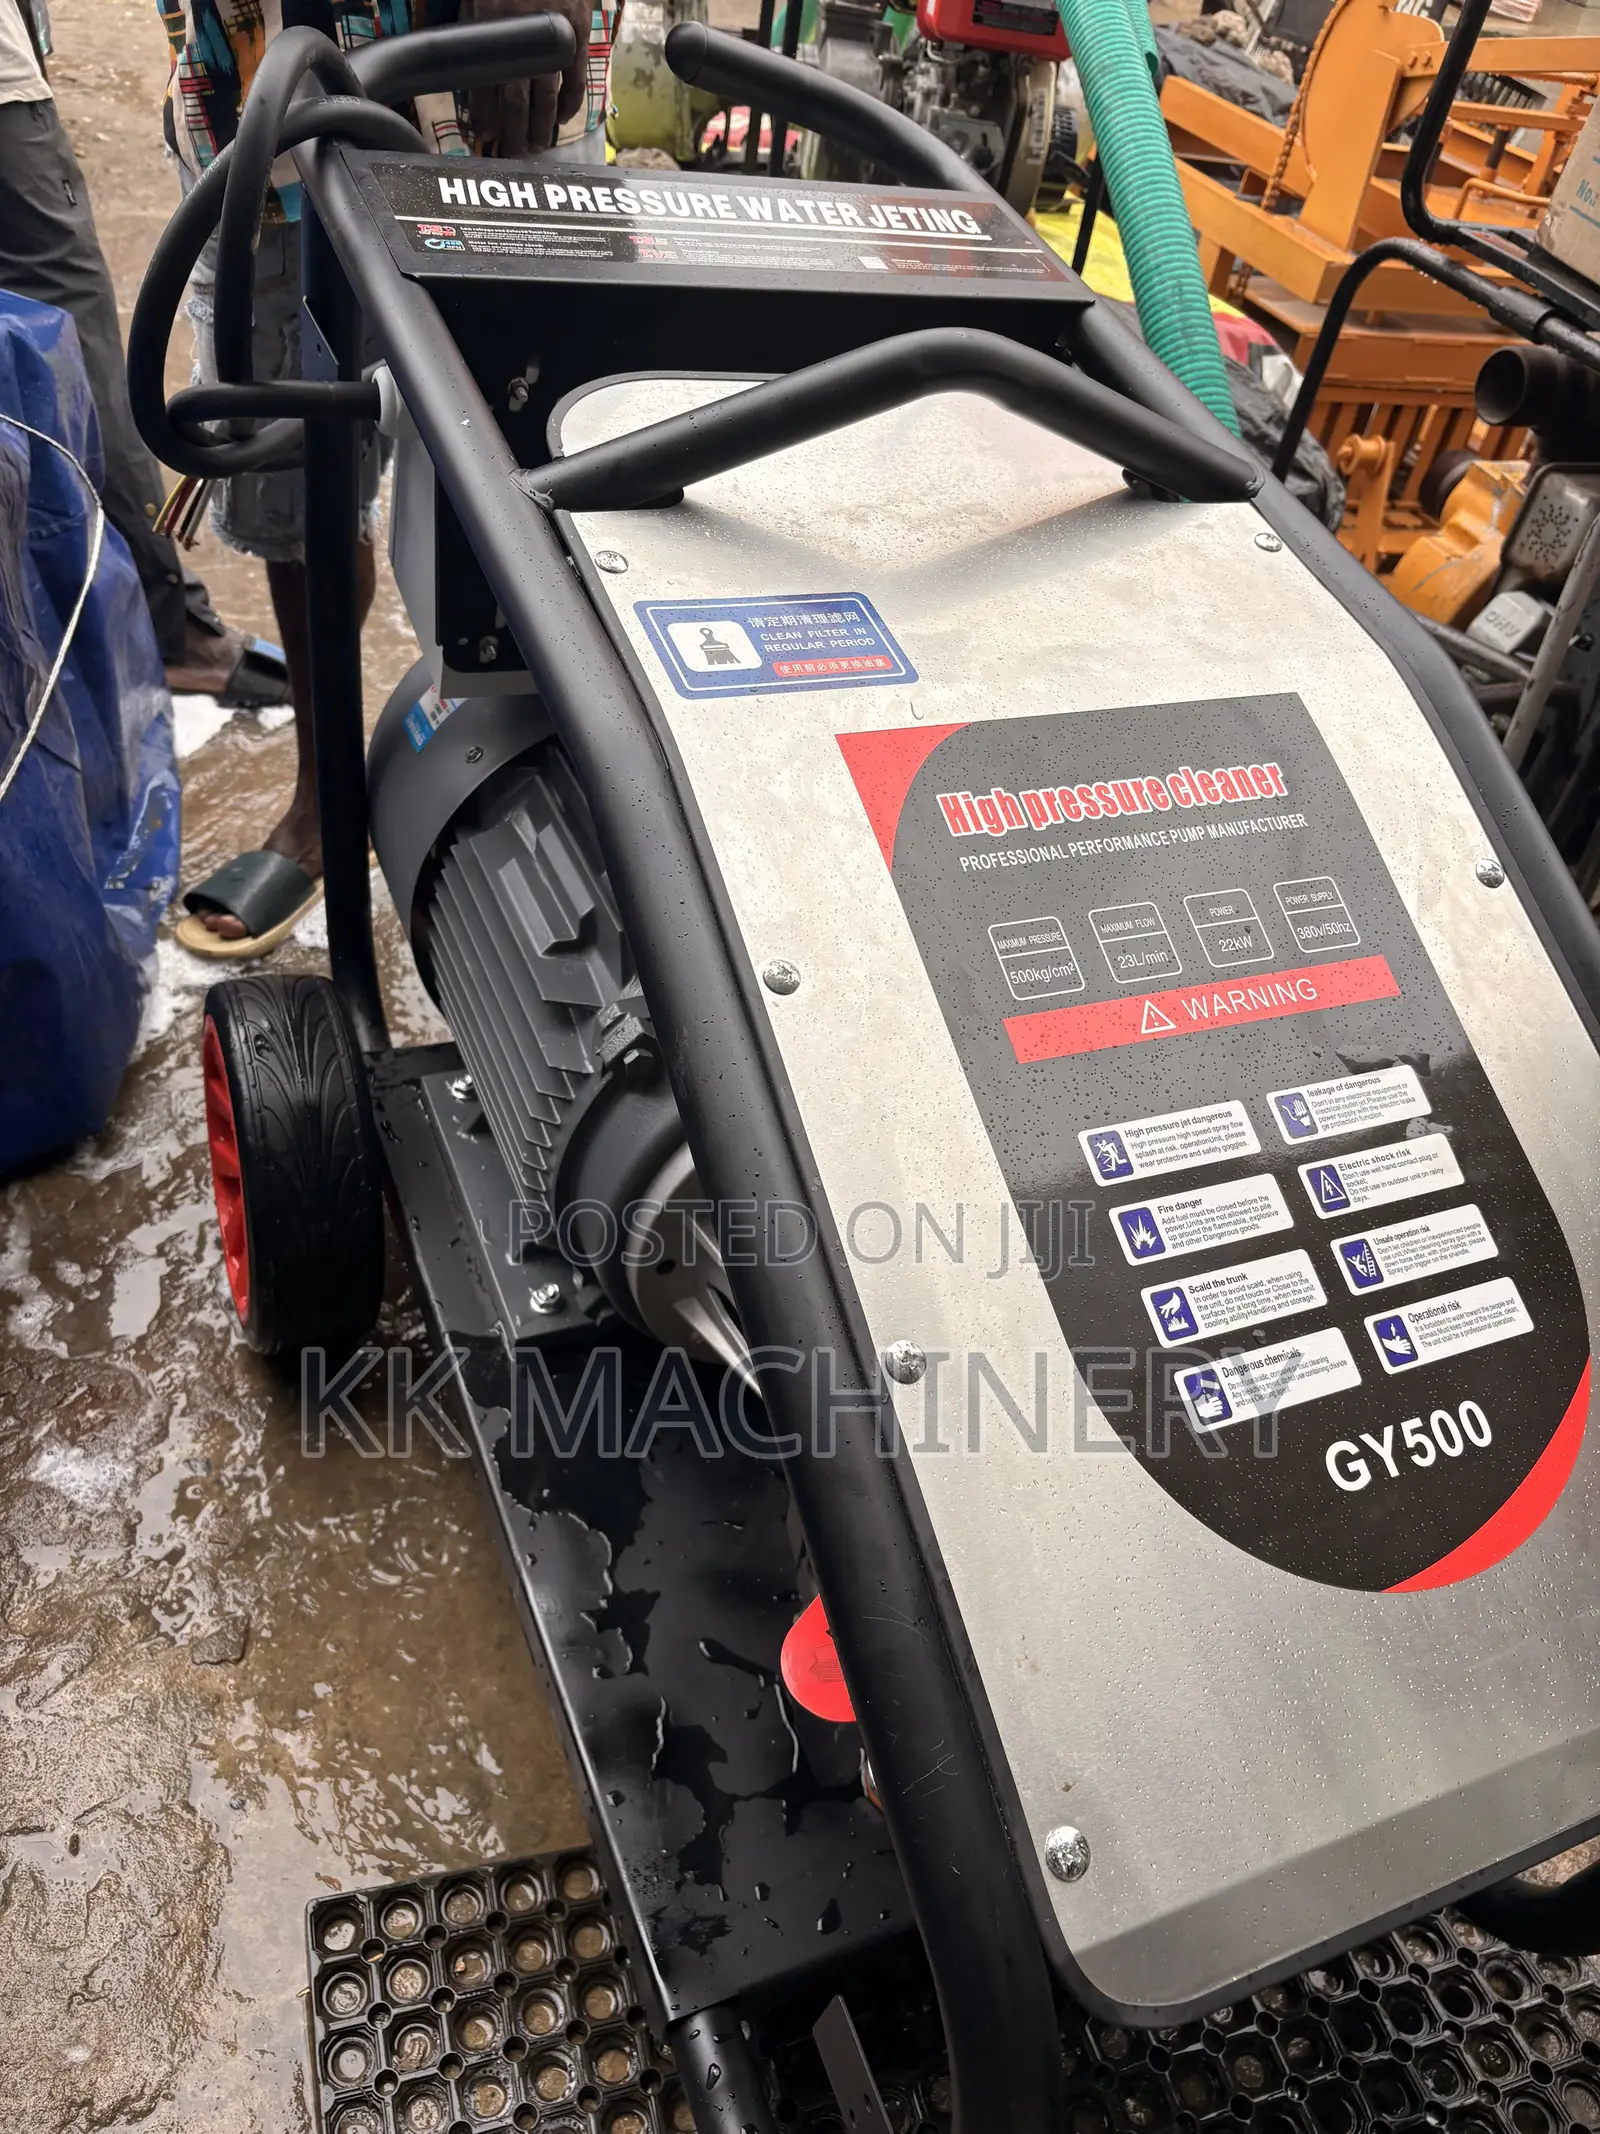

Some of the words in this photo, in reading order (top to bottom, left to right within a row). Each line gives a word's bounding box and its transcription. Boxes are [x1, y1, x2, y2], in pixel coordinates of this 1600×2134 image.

[438, 177, 536, 209] HIGH
[541, 184, 737, 219] PRESSURE
[738, 195, 866, 228] WATER
[869, 204, 982, 234] JETING
[748, 611, 861, 629] 请定期清理滤网
[760, 631, 802, 641] CLEAN
[808, 629, 849, 638] FILTER
[854, 627, 867, 635] IN
[764, 641, 824, 652] REGULAR
[829, 638, 876, 648] PERIOD
[936, 787, 1028, 836] High
[1019, 776, 1172, 831] pressure
[1166, 762, 1288, 808] cleaner
[959, 844, 1069, 872] PROFESSIONAL
[1068, 830, 1171, 858] PERFORMANCE
[1170, 825, 1205, 844] PUMP
[1206, 813, 1308, 839] MANUFACTURER
[1284, 894, 1310, 906] POWER
[1310, 891, 1334, 902] SUPPLY
[1209, 905, 1235, 917] POWER
[1100, 921, 1133, 934] MAXIMUM
[1135, 917, 1155, 928] FLOW
[1297, 921, 1352, 940] 380v/50hz
[997, 937, 1028, 949] MAXIMUM
[1029, 931, 1063, 945] PRESSURE
[1219, 936, 1252, 952] 22kW
[1117, 950, 1168, 969] 23L/min
[1181, 979, 1318, 1021] WARNING
[1336, 1083, 1343, 1091] of
[1344, 1077, 1381, 1089] dangerous
[1124, 1128, 1145, 1138] High
[1145, 1122, 1180, 1136] pressure
[1180, 1118, 1191, 1128] jet
[1192, 1111, 1232, 1124] dangerous
[1131, 1141, 1147, 1149] High
[1148, 1135, 1176, 1147] pressure
[1176, 1132, 1191, 1140] high
[1192, 1127, 1212, 1137] speed
[1212, 1125, 1229, 1133] spray
[1135, 1149, 1157, 1159] splash
[1225, 1131, 1246, 1141] please
[1139, 1160, 1155, 1168] wear
[1156, 1154, 1188, 1166] protective
[1189, 1150, 1201, 1158] and
[1202, 1146, 1221, 1155] safety
[1222, 1141, 1249, 1152] goggles.
[1338, 1159, 1370, 1171] Electric
[1371, 1153, 1395, 1163] shock
[1396, 1149, 1411, 1158] risk
[1381, 1162, 1397, 1171] hand
[1397, 1157, 1418, 1167] contact
[1418, 1155, 1432, 1163] plug
[1387, 1176, 1409, 1186] outdoor
[1157, 1206, 1174, 1214] Fire
[1175, 1199, 1202, 1210] danger
[1353, 1195, 1370, 1203] days.
[1162, 1216, 1175, 1225] Add
[1176, 1213, 1189, 1221] fuel
[1189, 1210, 1206, 1218] must
[1216, 1202, 1237, 1212] closed
[1237, 1198, 1258, 1207] before
[1216, 1213, 1227, 1221] not
[1227, 1207, 1252, 1218] allowed
[1260, 1203, 1271, 1212] pile
[1178, 1228, 1201, 1239] around
[1213, 1218, 1249, 1230] flammable,
[1249, 1210, 1279, 1222] explosive
[1172, 1240, 1185, 1249] and
[1185, 1237, 1202, 1246] other
[1203, 1229, 1239, 1241] Dangerous
[1240, 1223, 1261, 1234] goods.
[1188, 1281, 1212, 1294] Scald
[1212, 1280, 1226, 1288] the
[1226, 1273, 1248, 1284] trunk
[1202, 1292, 1219, 1302] order
[1228, 1285, 1246, 1295] avoid
[1247, 1280, 1266, 1290] scald,
[1266, 1276, 1284, 1284] when
[1284, 1271, 1303, 1280] using
[1234, 1294, 1246, 1302] not
[1245, 1289, 1264, 1299] touch
[1272, 1283, 1291, 1292] Close
[1201, 1309, 1226, 1320] surface
[1241, 1301, 1257, 1309] long
[1256, 1297, 1274, 1305] time,
[1273, 1292, 1291, 1300] when
[1303, 1285, 1316, 1293] unit
[1204, 1318, 1229, 1329] cooling
[1277, 1300, 1290, 1309] and
[1290, 1295, 1316, 1305] storage.
[1221, 1360, 1264, 1378] Dangerous
[1264, 1347, 1302, 1366] chemicals
[1325, 1400, 1492, 1492] GY500
